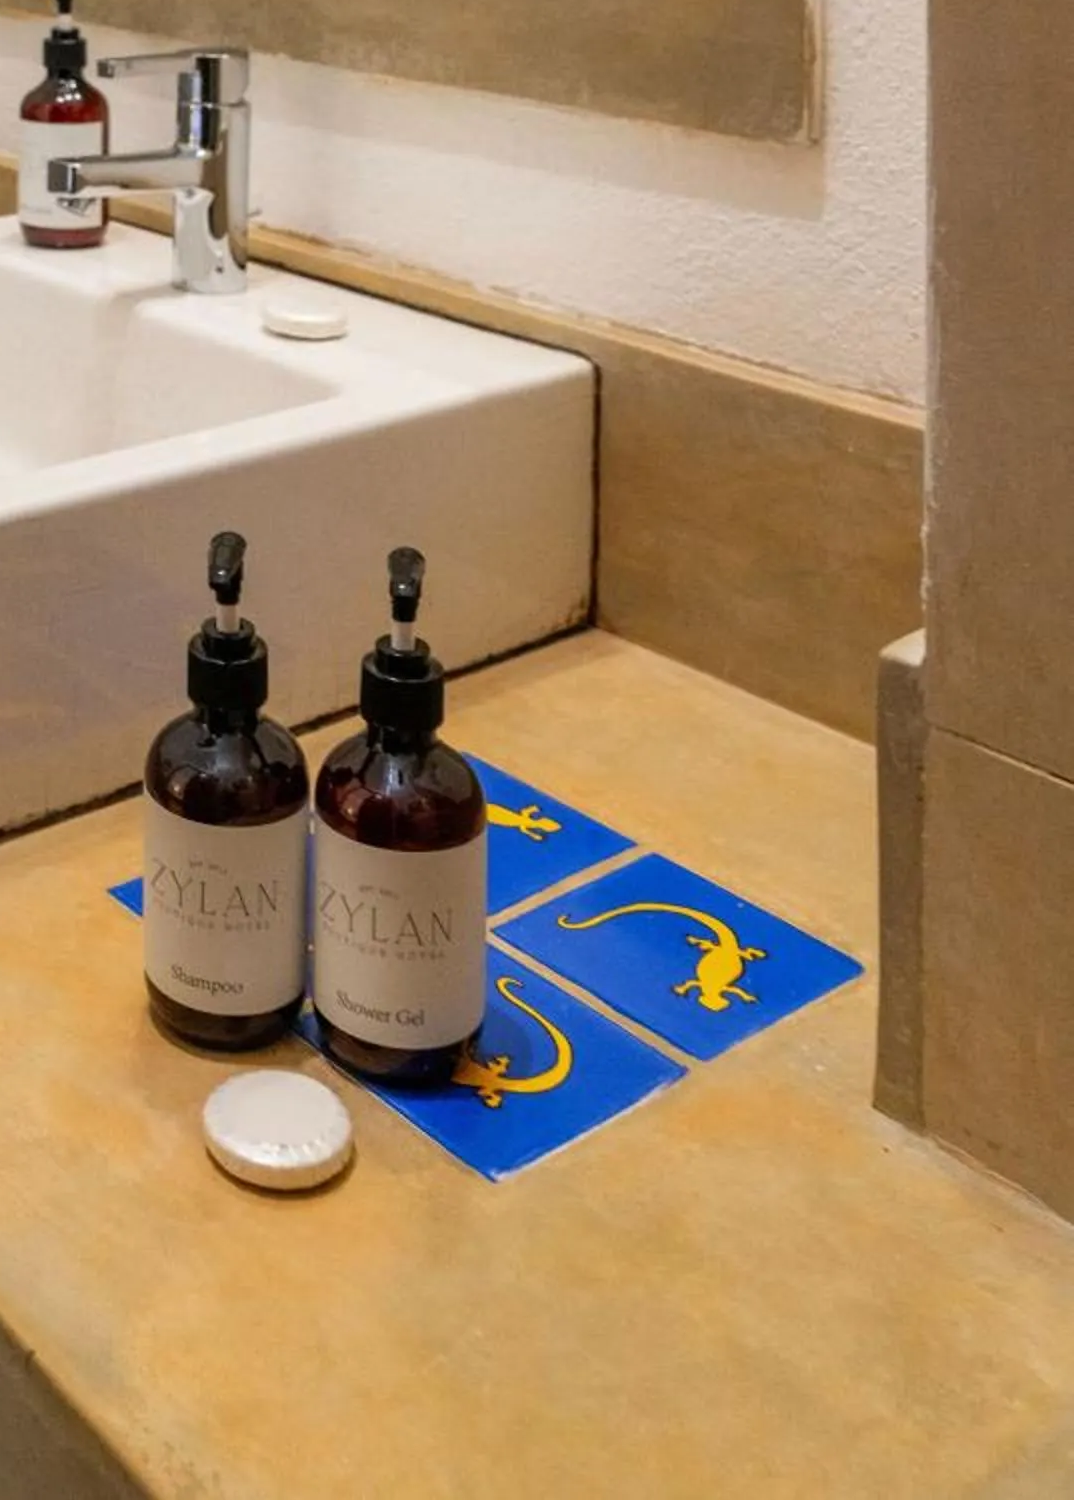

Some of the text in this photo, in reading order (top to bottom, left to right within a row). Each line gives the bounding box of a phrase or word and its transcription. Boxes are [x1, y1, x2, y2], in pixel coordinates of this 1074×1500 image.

[150, 856, 278, 917] ZYLAN
[319, 880, 452, 946] ZYLAN
[171, 964, 244, 997] Shampoo
[335, 989, 425, 1028] Shower Gel
